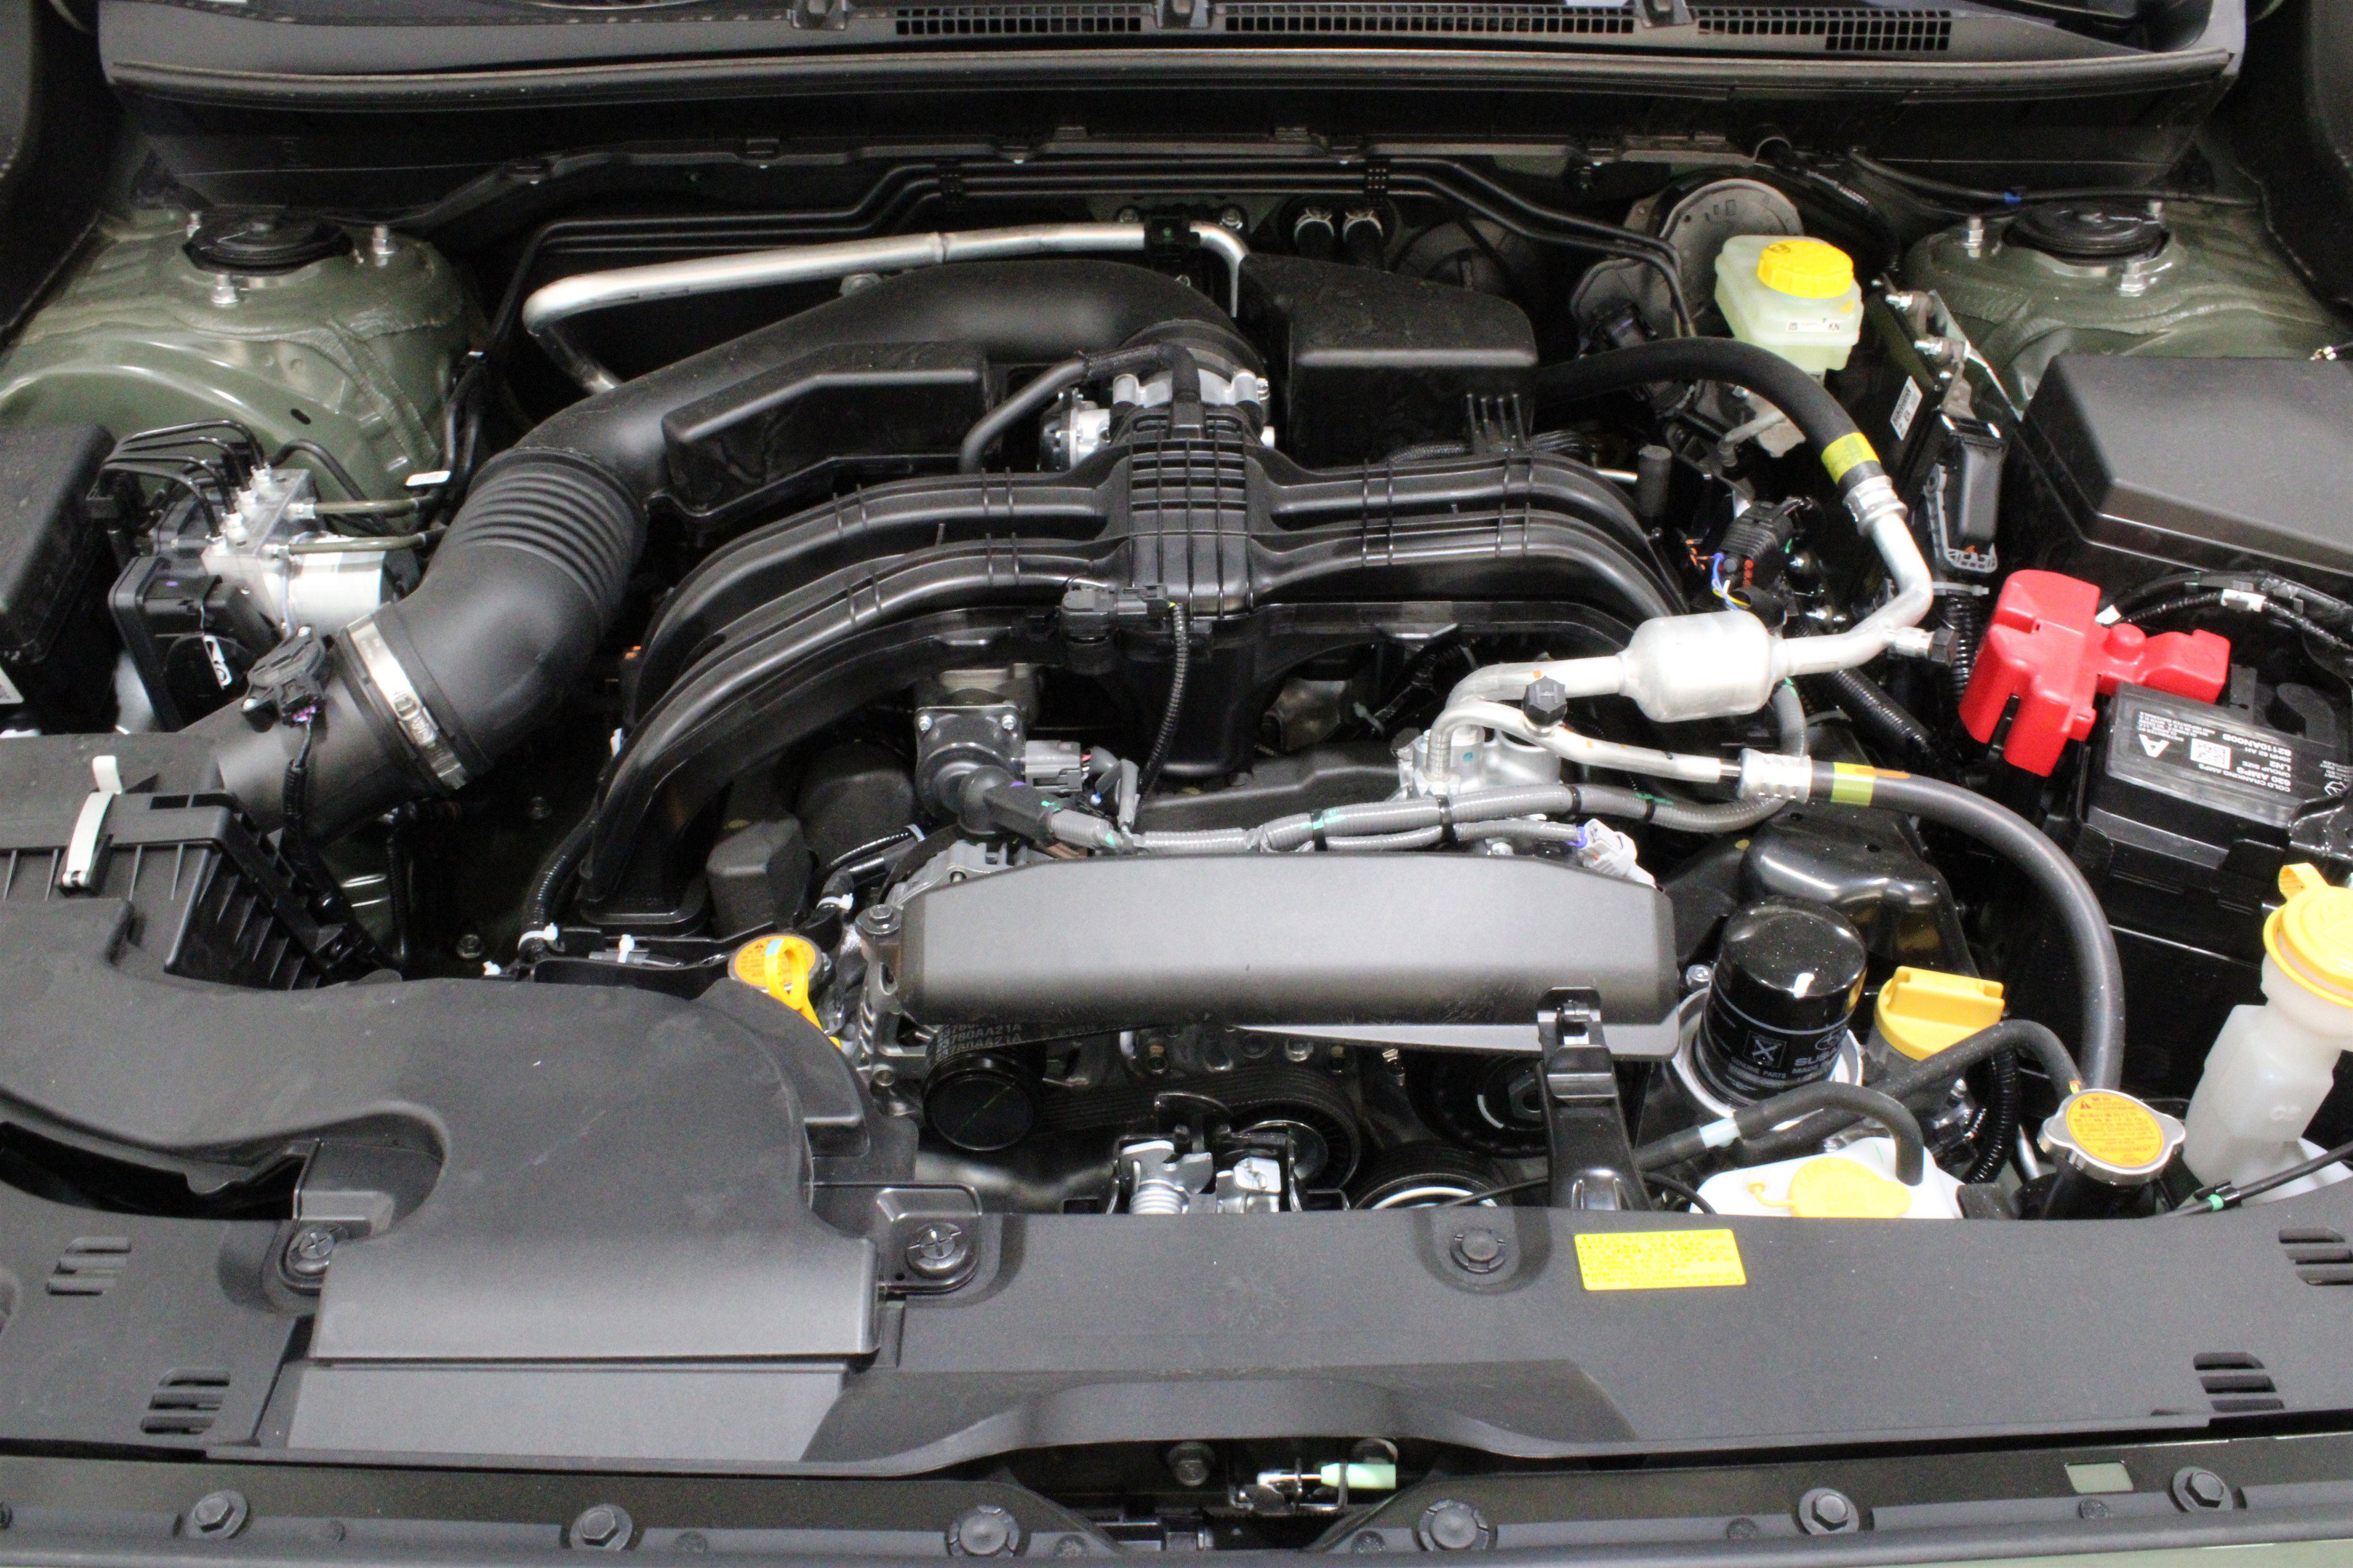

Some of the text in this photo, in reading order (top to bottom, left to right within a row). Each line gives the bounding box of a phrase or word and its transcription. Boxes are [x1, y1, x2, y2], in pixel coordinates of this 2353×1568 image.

[1829, 322, 1841, 331] KN
[2223, 734, 2292, 756] 82110AN00B
[2242, 761, 2290, 778] GROUP SIZE
[2270, 761, 2290, 771] LN2
[2198, 763, 2290, 792] COLD CRANKING AMPS
[2236, 767, 2290, 786] 620 AMPS
[1762, 1069, 1787, 1079] PARTS
